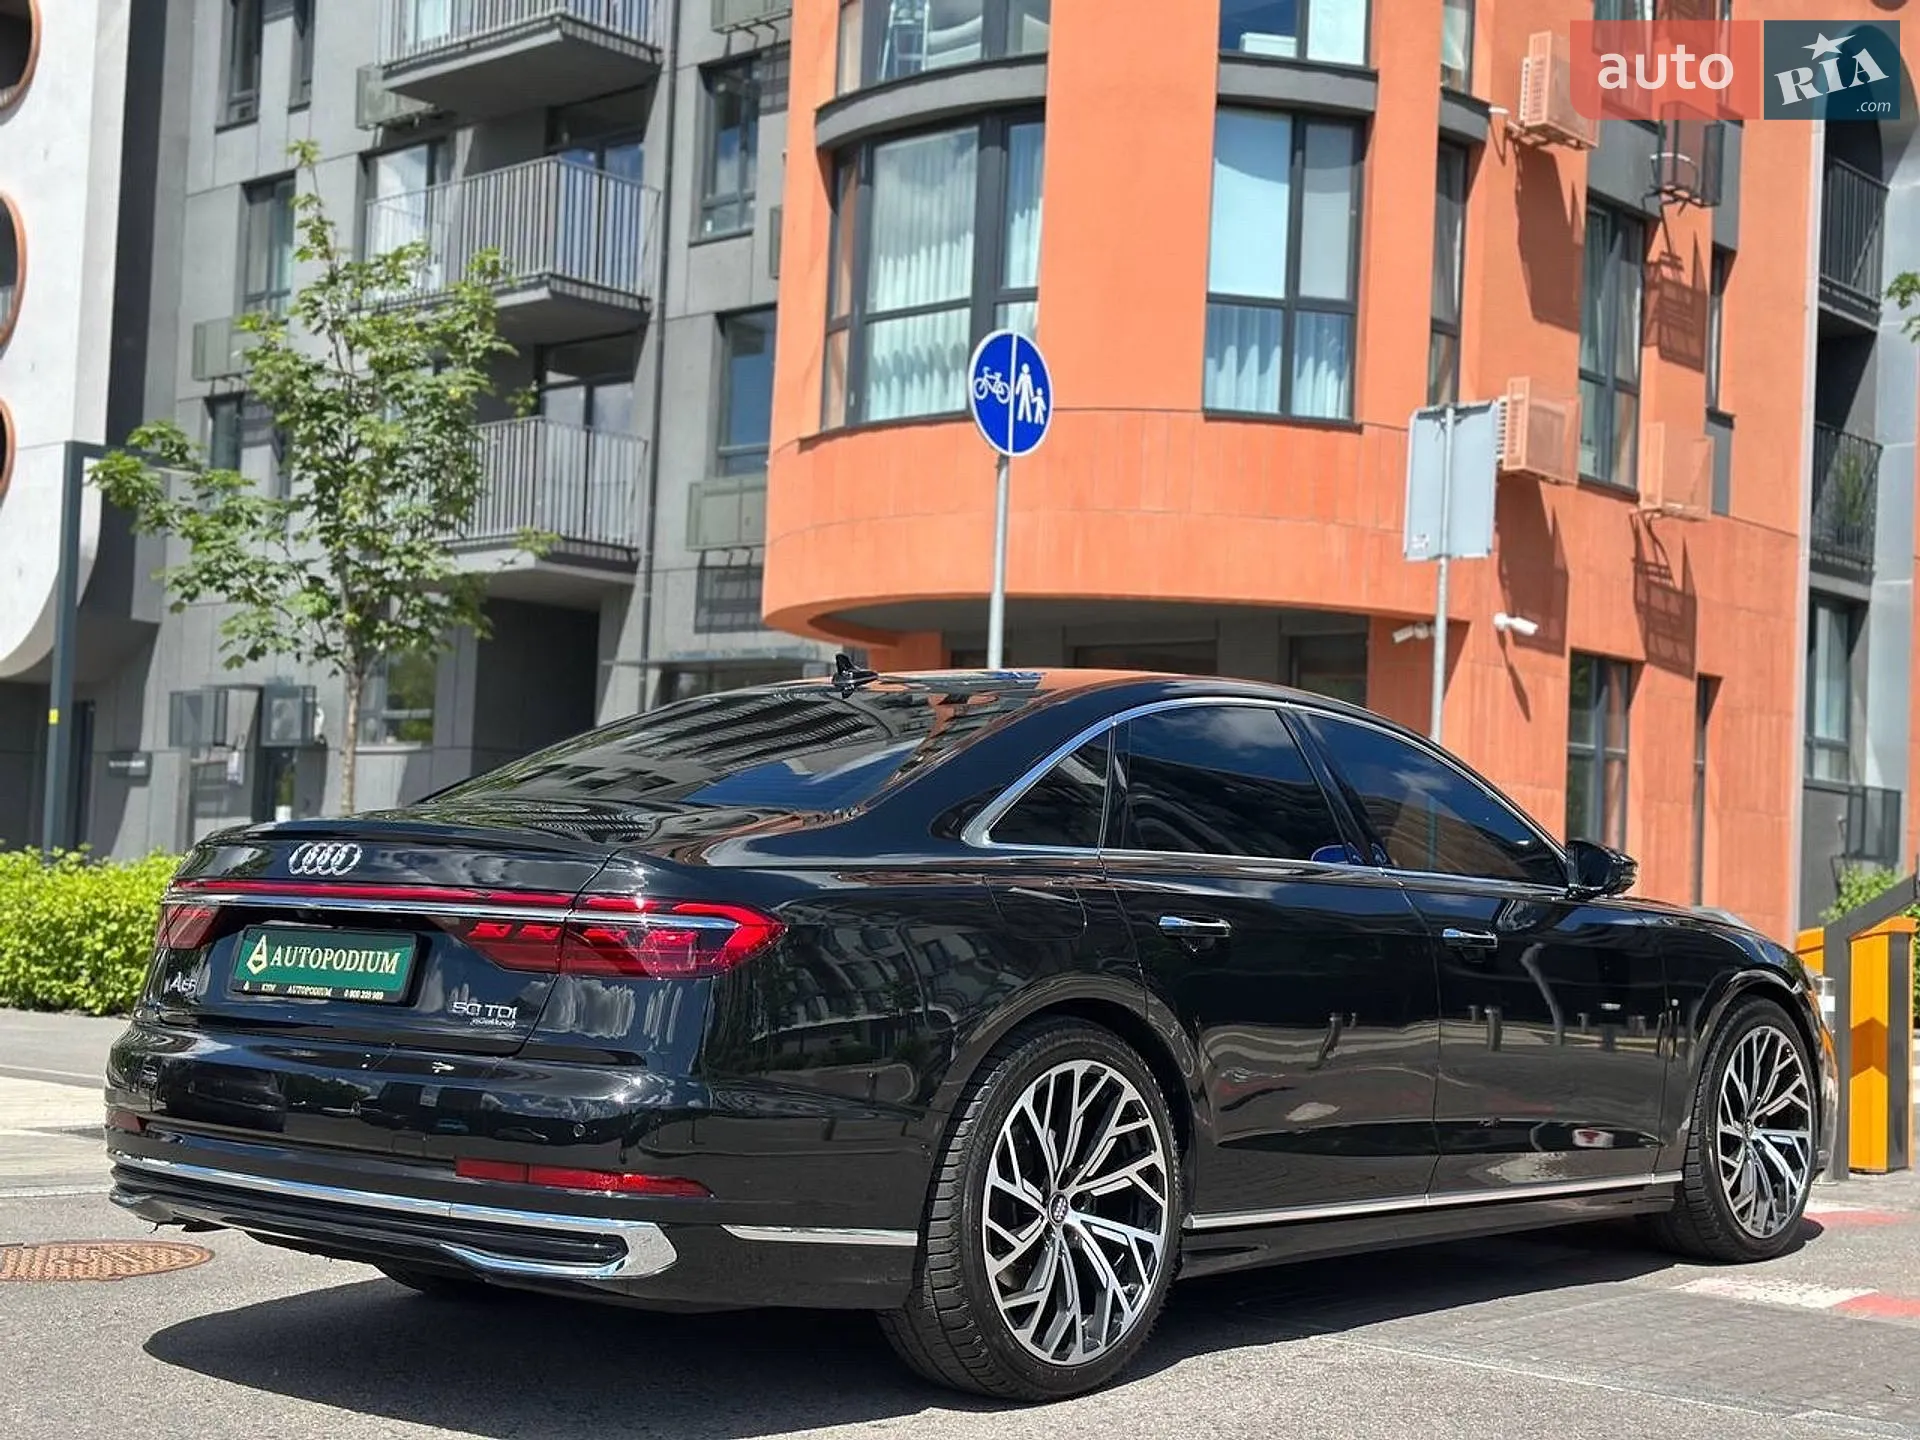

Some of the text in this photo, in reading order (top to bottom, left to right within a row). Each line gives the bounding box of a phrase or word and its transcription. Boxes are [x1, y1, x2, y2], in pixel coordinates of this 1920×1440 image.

[270, 945, 400, 974] AUTOPODIUM
[452, 1001, 518, 1020] 50 TDI
